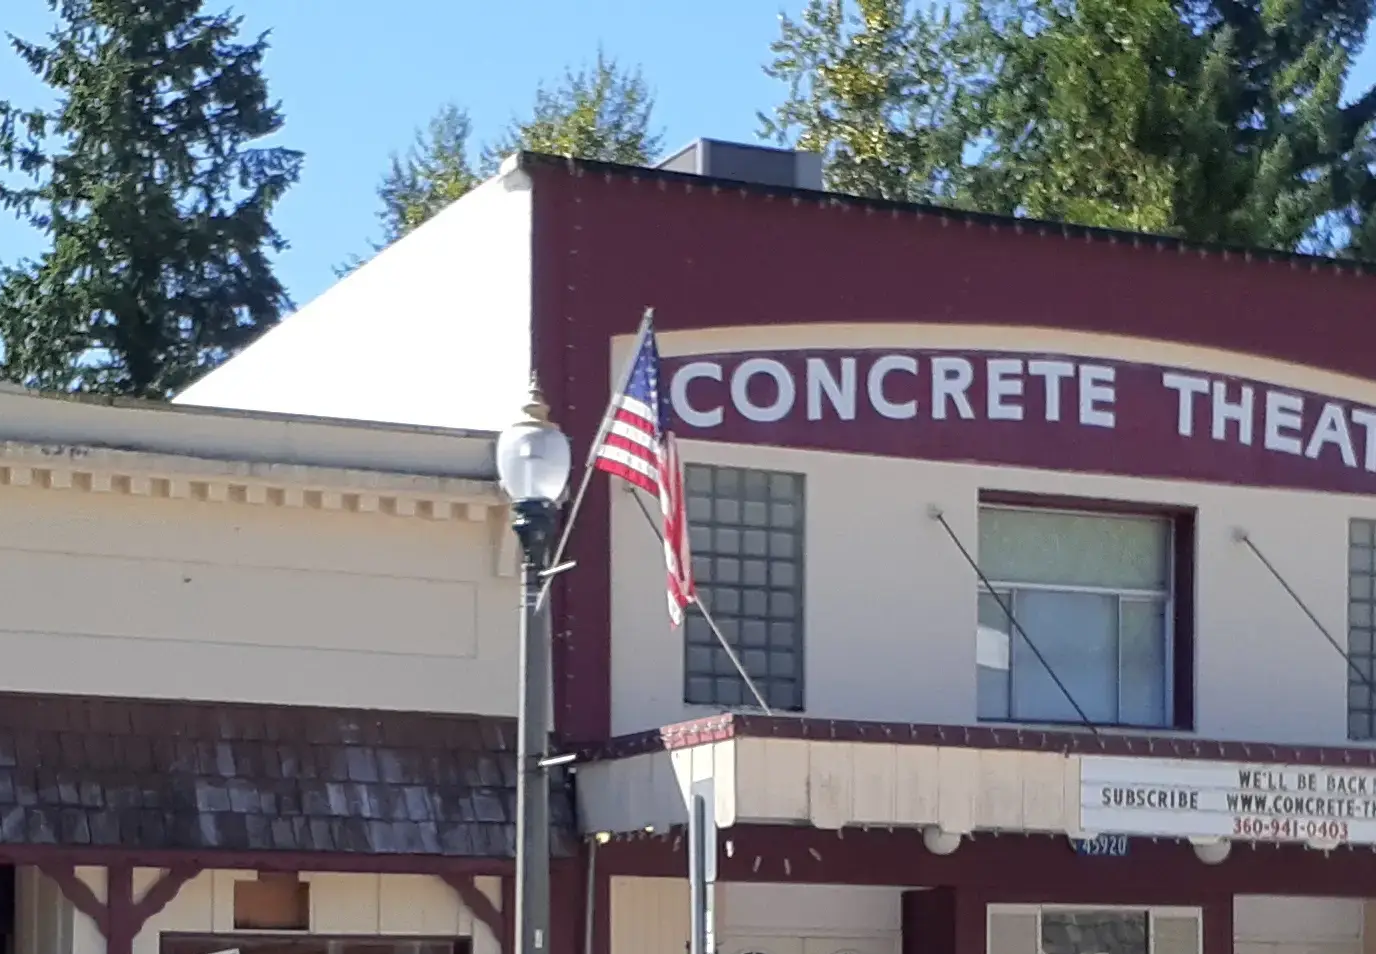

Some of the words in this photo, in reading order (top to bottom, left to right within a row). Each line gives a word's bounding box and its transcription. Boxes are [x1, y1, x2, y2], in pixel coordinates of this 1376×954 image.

[670, 354, 1116, 428] CONCRETE
[1238, 769, 1287, 791] WE'LL
[1297, 771, 1317, 791] BE
[1101, 787, 1199, 810] SUBSCRIBE
[1232, 818, 1349, 840] 360-941-0403
[1082, 837, 1126, 856] 45920
